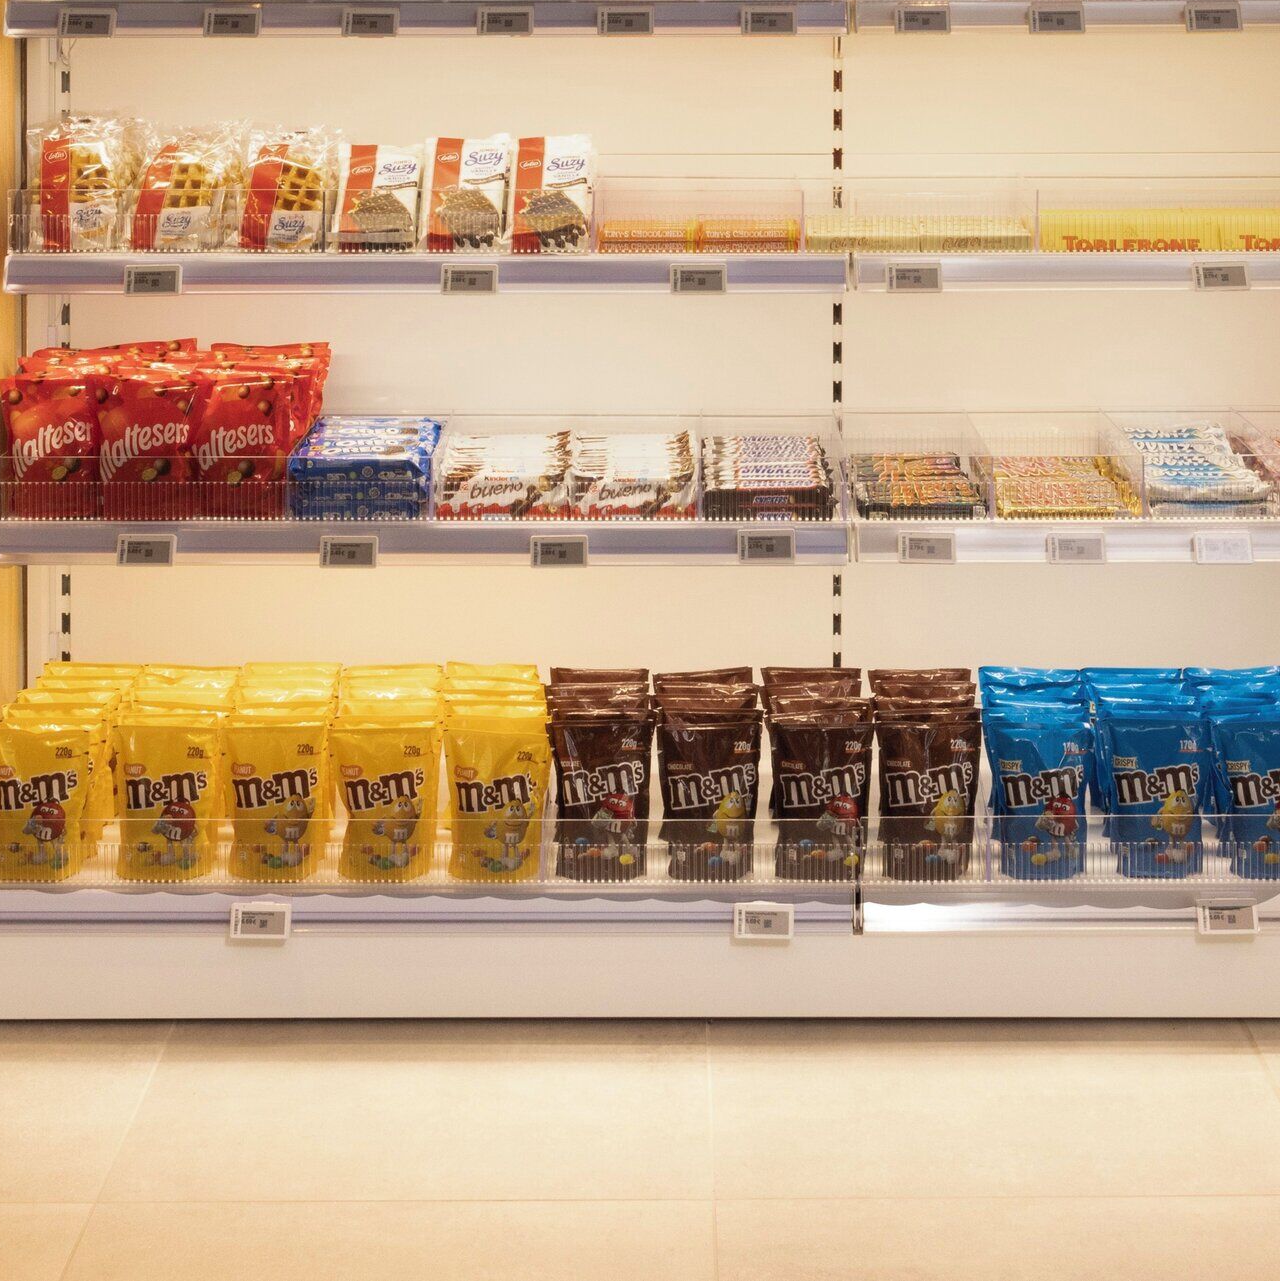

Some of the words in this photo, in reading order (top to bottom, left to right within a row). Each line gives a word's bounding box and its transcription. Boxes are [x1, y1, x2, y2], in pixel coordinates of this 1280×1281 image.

[464, 151, 503, 167] Suzy
[546, 157, 586, 172] Suzy
[378, 162, 417, 176] Suzy
[273, 216, 306, 234] Suzy
[12, 421, 94, 480] Malteser
[470, 481, 523, 499] bueno
[598, 483, 652, 501] bueno
[55, 746, 72, 758] 220g
[297, 743, 314, 756] 220g
[404, 745, 420, 757] 220g
[734, 741, 751, 752] 220g
[125, 770, 208, 811] m&m's
[231, 767, 318, 809] m&m's
[343, 767, 425, 812] m&m's
[562, 760, 644, 807] m&m's
[668, 763, 757, 811] m&m's
[780, 761, 865, 808] m&m's
[885, 762, 973, 808] m&m's
[1112, 762, 1200, 806] m&m's
